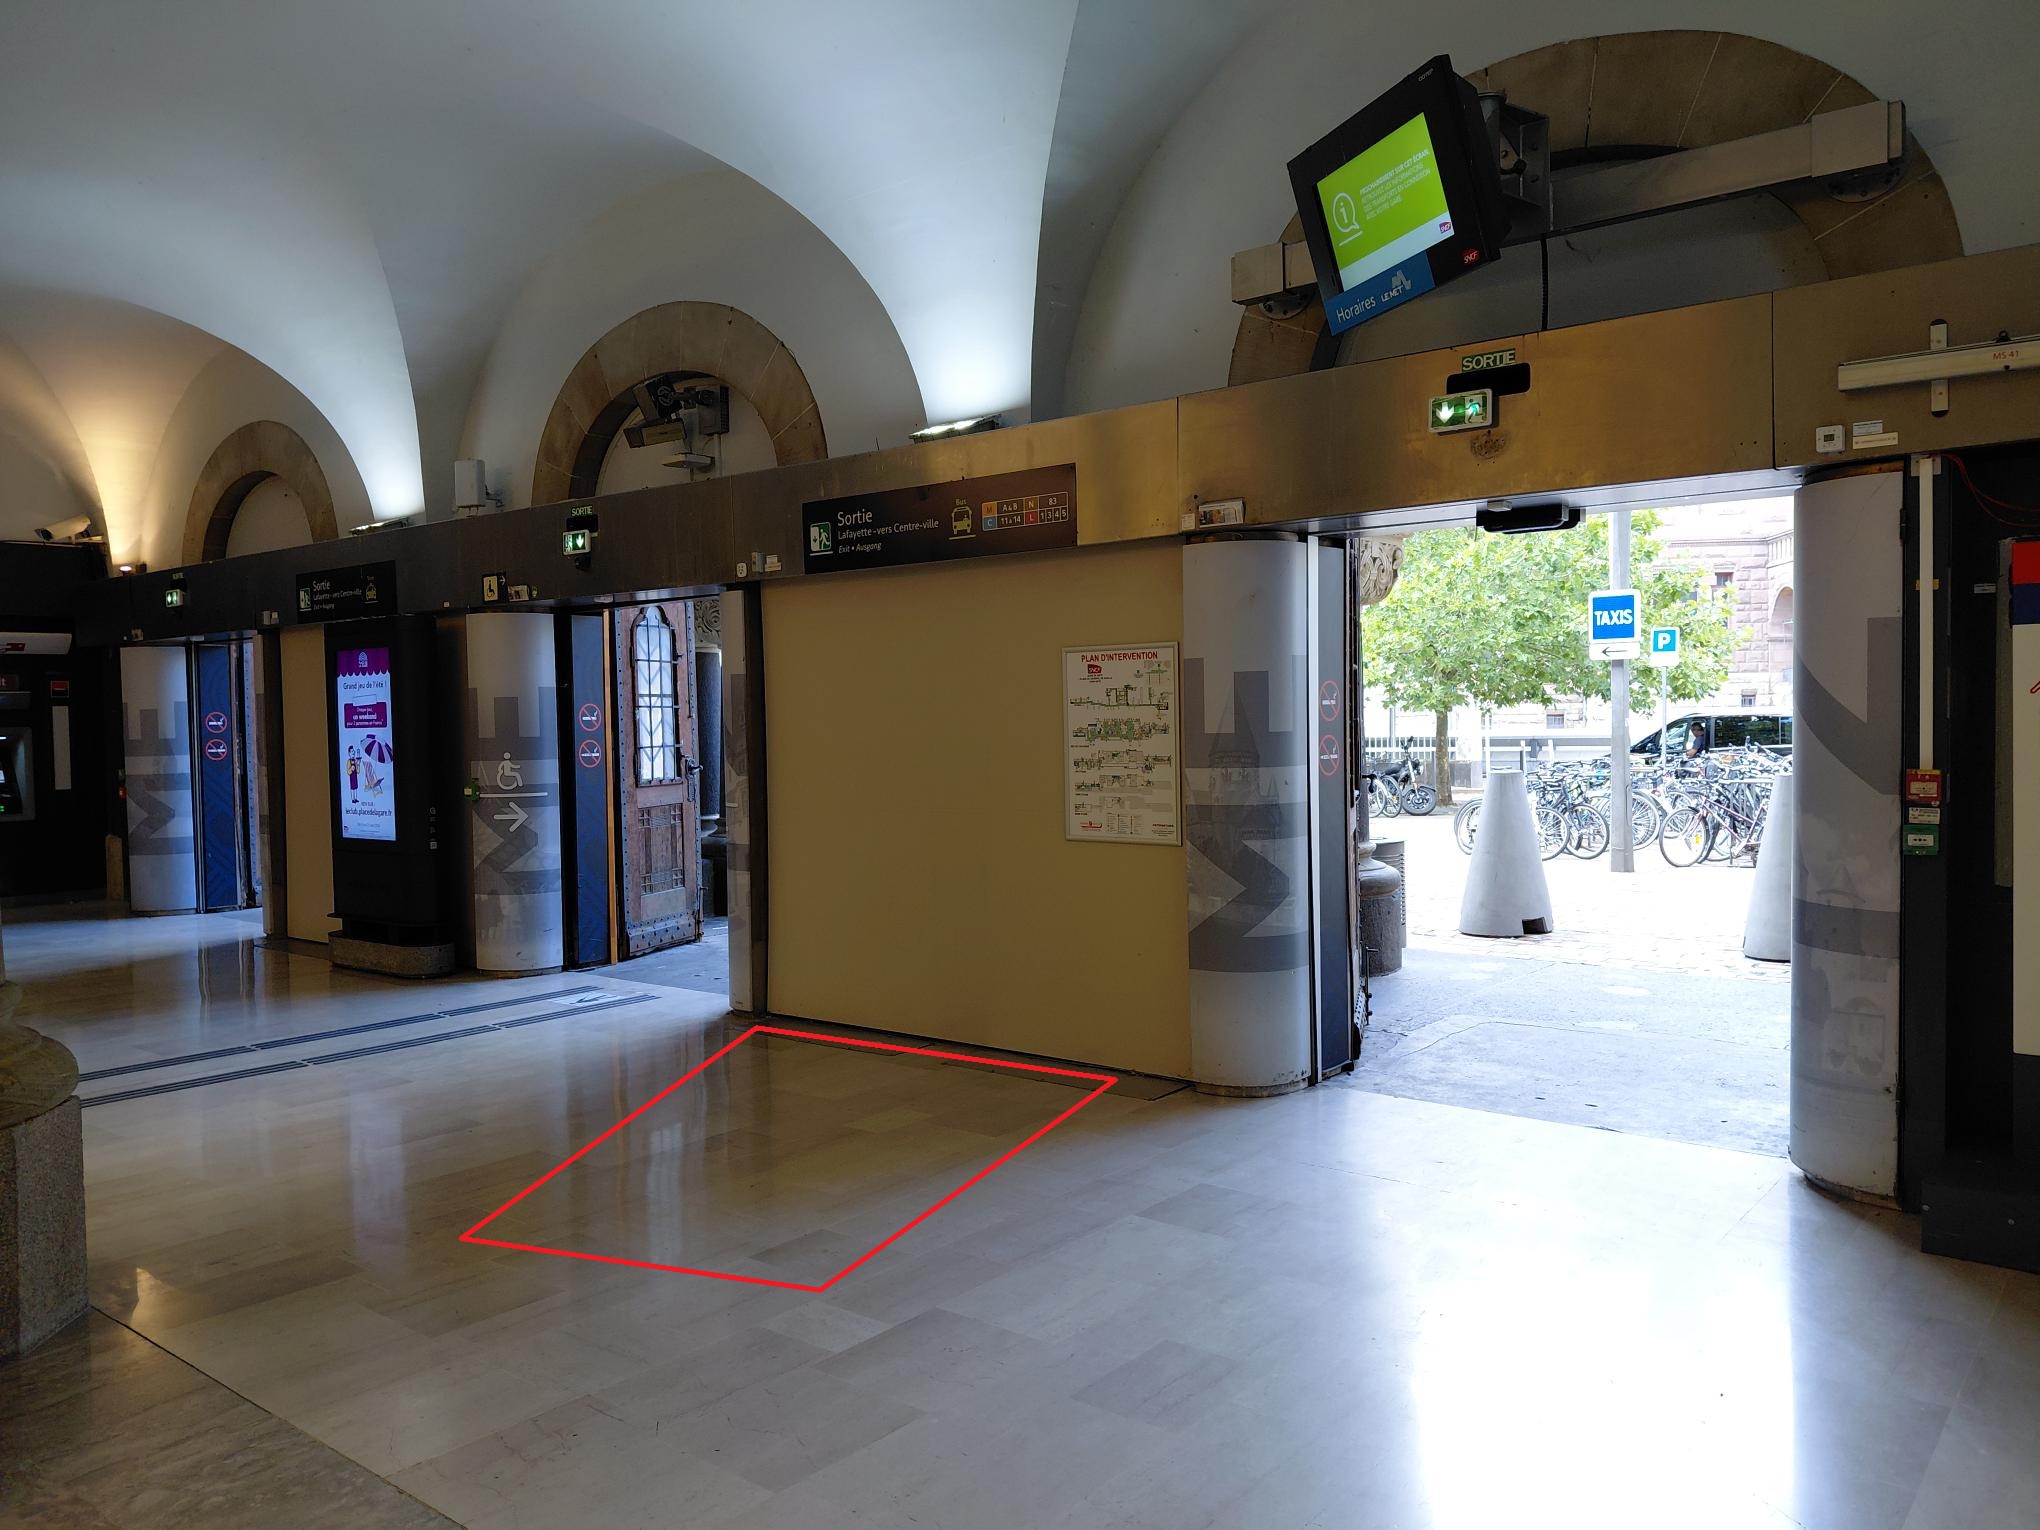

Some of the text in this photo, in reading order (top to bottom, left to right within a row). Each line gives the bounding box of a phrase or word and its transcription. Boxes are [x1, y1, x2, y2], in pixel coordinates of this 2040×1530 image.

[1463, 251, 1479, 264] SNCF
[1336, 296, 1376, 323] Horaires
[1462, 351, 1516, 371] SORTIE
[571, 505, 593, 517] SORTIE
[1002, 504, 1008, 512] A
[1028, 501, 1034, 509] N
[1048, 497, 1057, 506] 83
[837, 509, 873, 526] Sortie
[1001, 516, 1009, 525] 11
[1013, 515, 1021, 524] 14
[838, 528, 872, 541] Lafayette
[877, 525, 893, 535] vers
[893, 518, 939, 533] Centre-ville
[838, 545, 850, 554] Exit
[313, 579, 331, 592] Sortie
[1594, 609, 1633, 626] TAXIS
[1081, 651, 1158, 662] PLAN D'INTERVENTION
[343, 682, 357, 690] Grand
[357, 682, 365, 691] jeu
[365, 681, 372, 689] de
